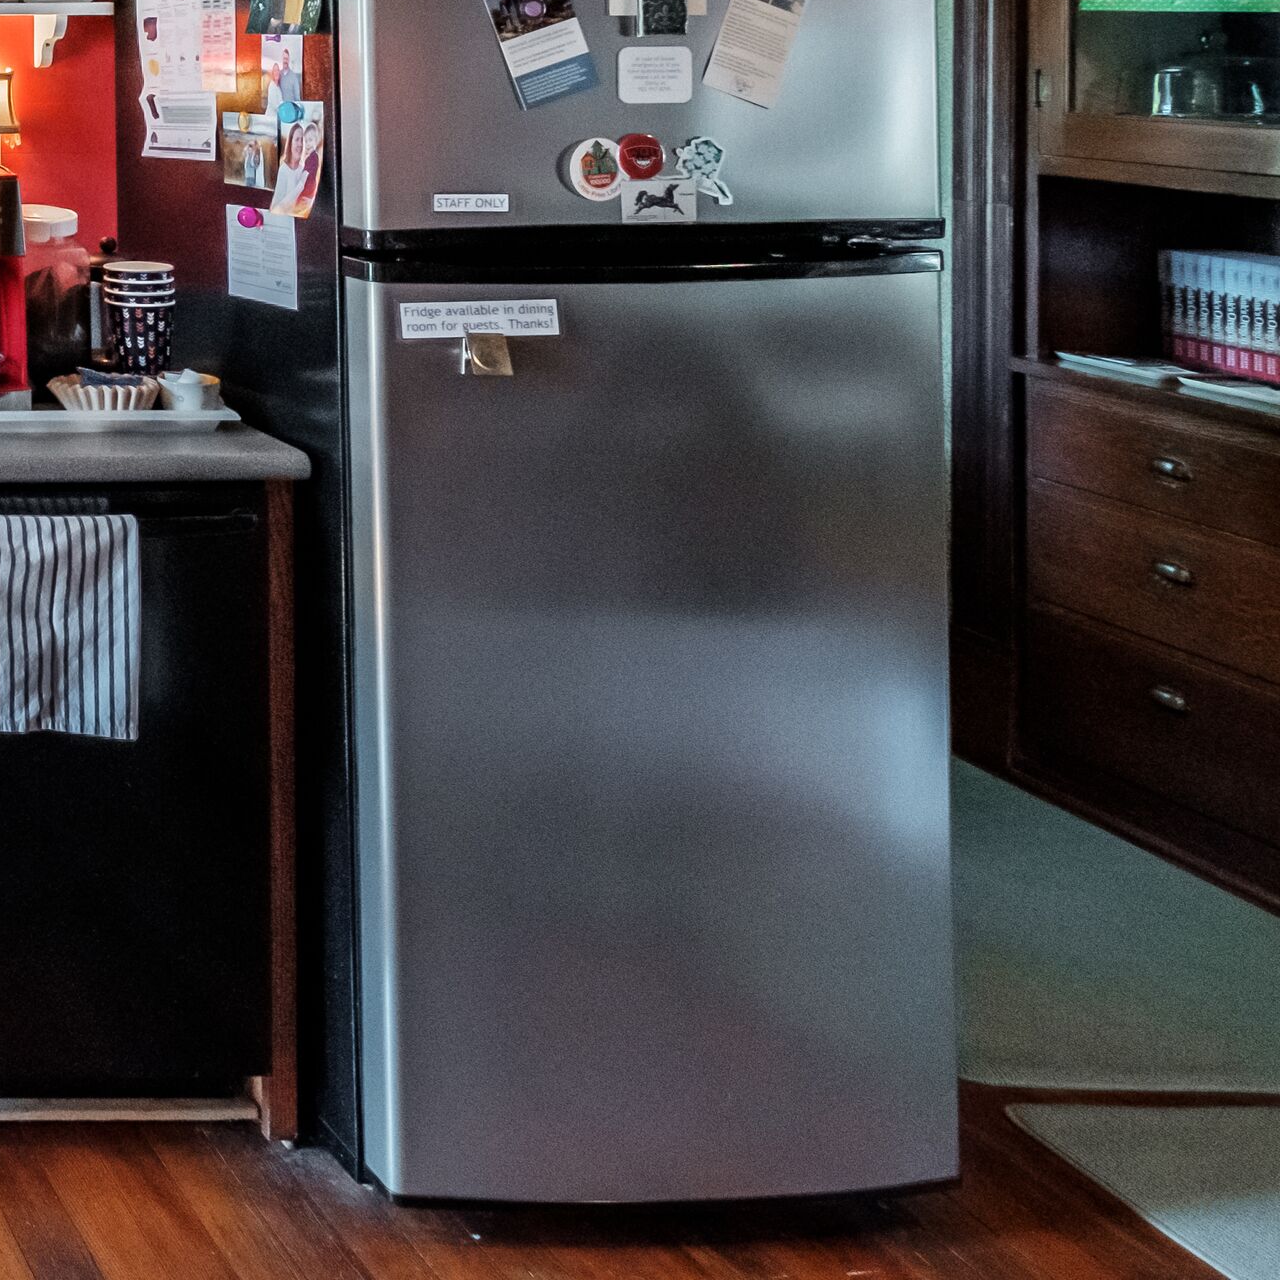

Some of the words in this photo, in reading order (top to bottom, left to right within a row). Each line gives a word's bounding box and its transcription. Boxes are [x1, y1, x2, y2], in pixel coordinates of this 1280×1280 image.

[437, 198, 471, 208] STAFF
[475, 198, 506, 208] ONLY
[404, 307, 441, 319] Fridge
[445, 305, 499, 316] available
[504, 305, 514, 314] in
[518, 304, 554, 316] dining
[407, 323, 437, 331] room
[441, 321, 458, 331] for
[463, 321, 504, 333] guests.
[508, 319, 553, 329] Thanks!
